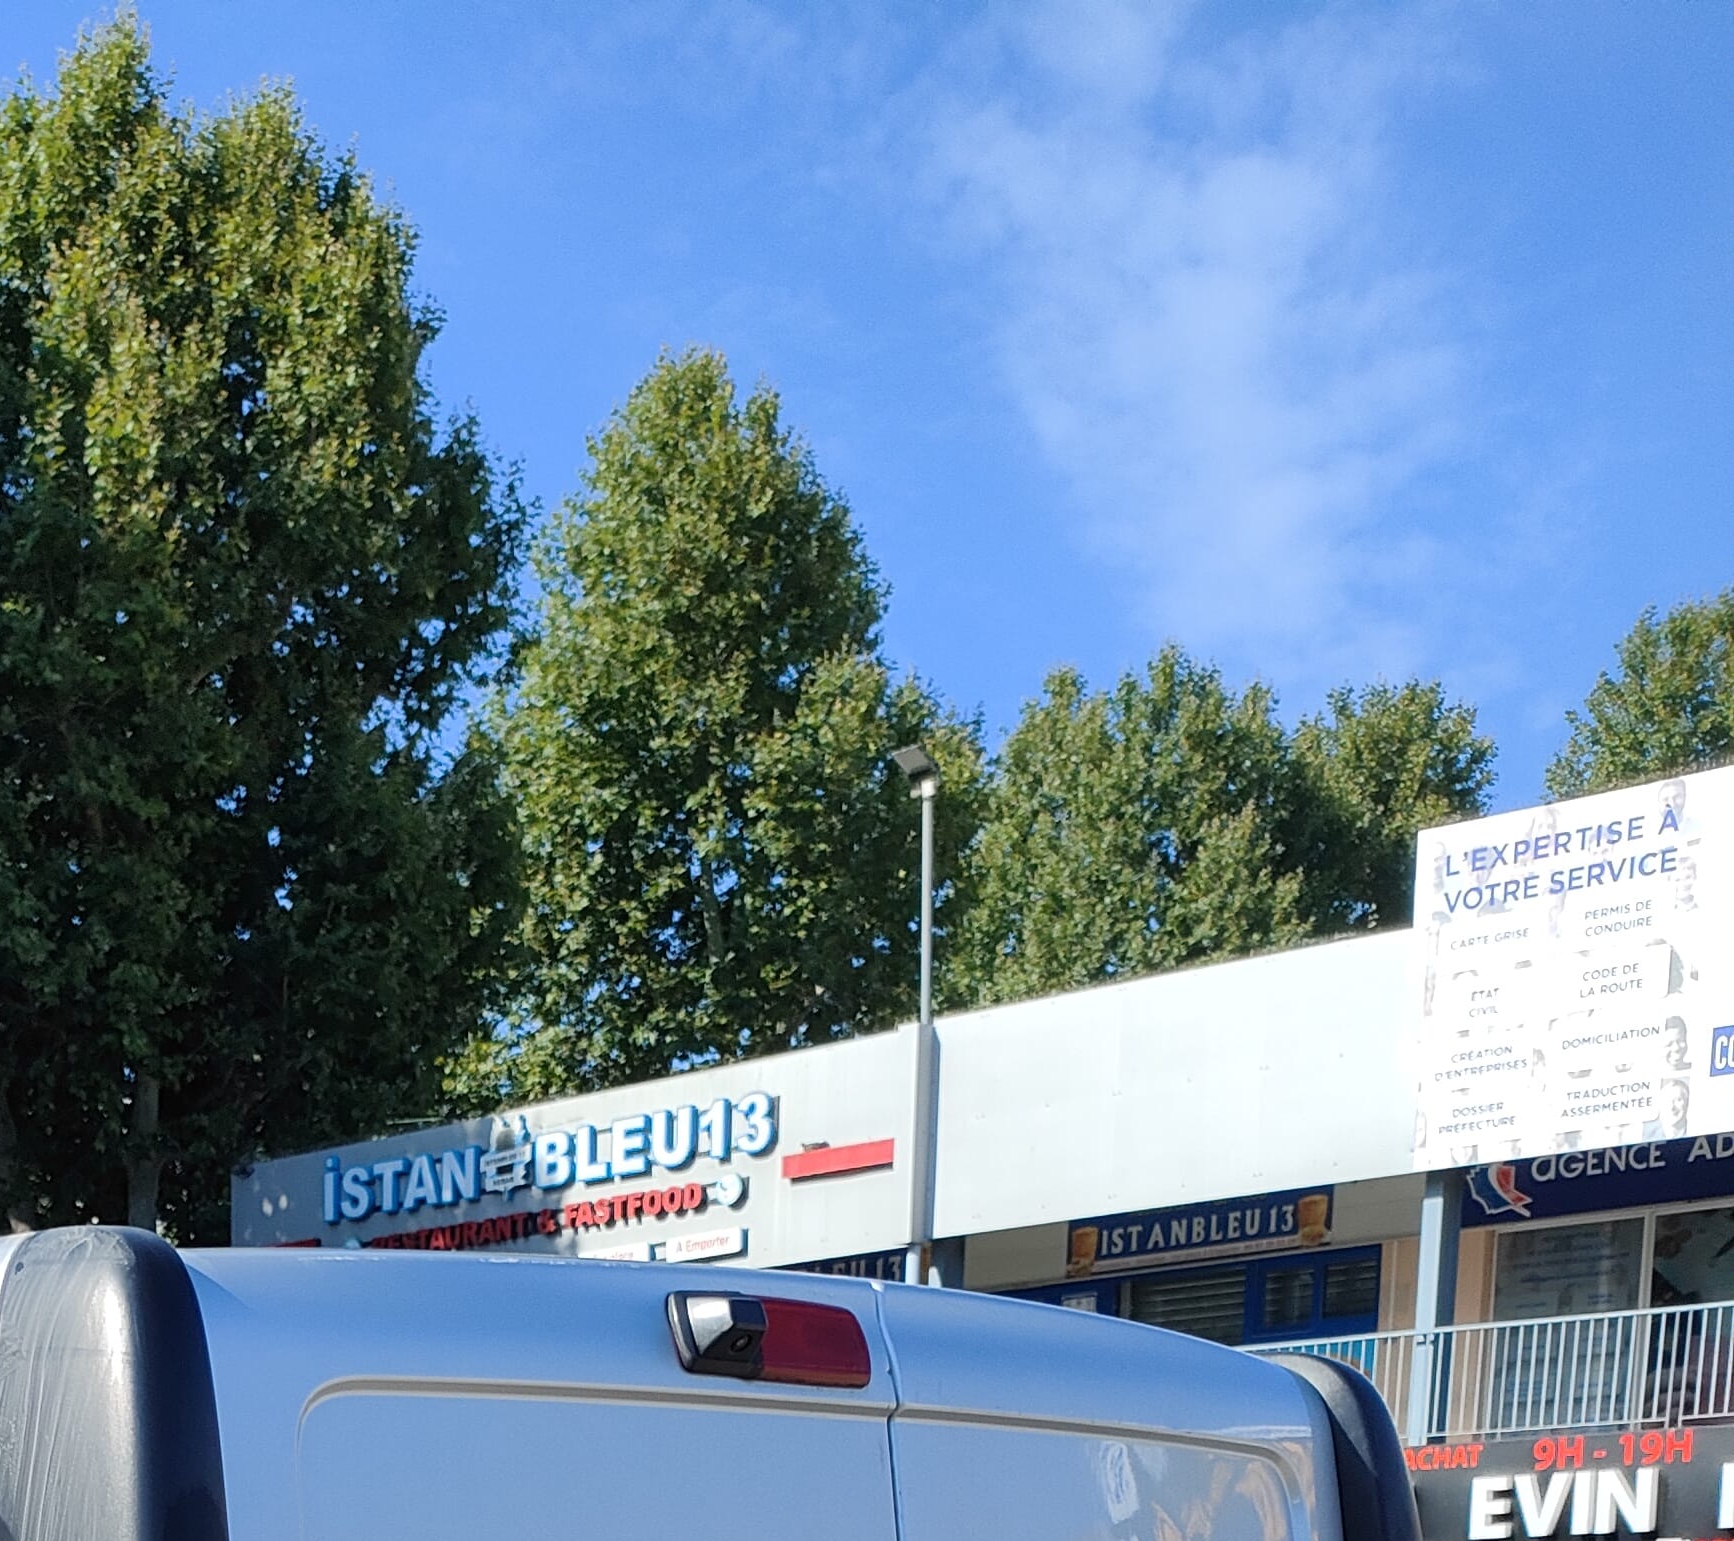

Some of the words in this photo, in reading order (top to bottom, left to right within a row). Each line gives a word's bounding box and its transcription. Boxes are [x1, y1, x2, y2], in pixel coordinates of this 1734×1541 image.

[1444, 815, 1646, 878] L'EXPERTISE
[1657, 802, 1680, 836] À
[1443, 874, 1541, 914] VOTRE
[1548, 847, 1679, 895] SERVICE
[1583, 902, 1632, 921] PERMIS
[1634, 899, 1653, 912] DE
[1584, 915, 1654, 938] CONDUIRE
[1450, 935, 1490, 951] CARTE
[1494, 927, 1530, 945] GRISE
[1582, 966, 1619, 983] CODE
[1622, 962, 1640, 975] DE
[1580, 984, 1596, 999] LA
[1599, 978, 1643, 995] ROUTE
[1561, 1025, 1661, 1051] DOMICILIATION
[1566, 1081, 1651, 1101] TRADUCTION
[1451, 1101, 1505, 1119] DOSSIER
[564, 1182, 704, 1229] FASTFOOD
[1532, 1435, 1584, 1472] 9H
[1618, 1428, 1695, 1467] 19H
[1468, 1466, 1662, 1541] EVIN
